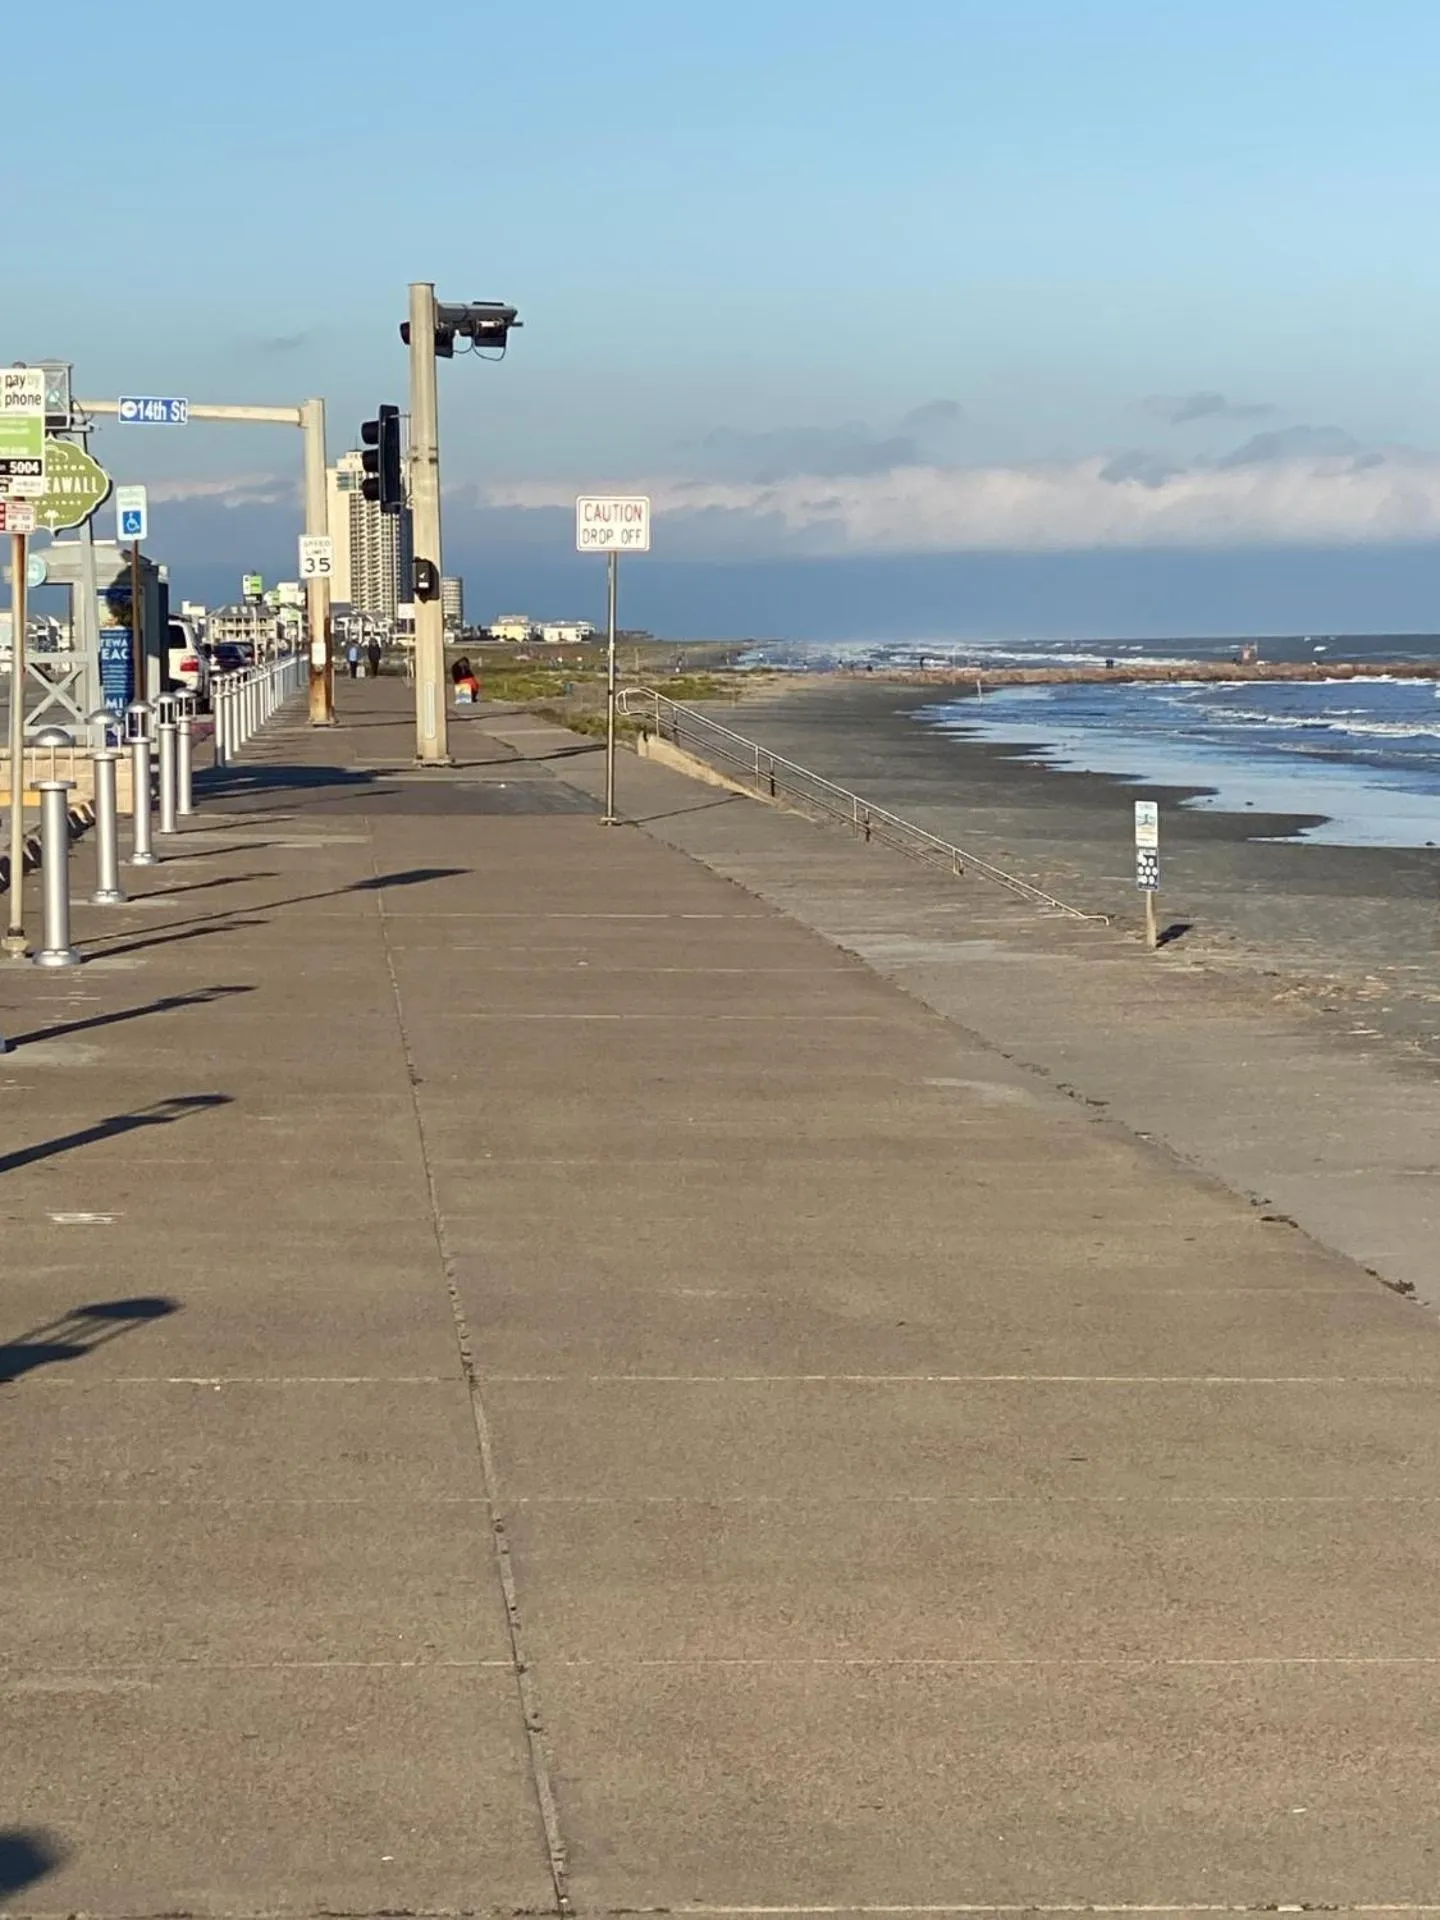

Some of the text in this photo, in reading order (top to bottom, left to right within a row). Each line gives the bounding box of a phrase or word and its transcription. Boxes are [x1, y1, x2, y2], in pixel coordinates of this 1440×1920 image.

[4, 374, 27, 390] pay
[4, 391, 42, 409] phone
[137, 399, 187, 422] 14th St
[9, 460, 40, 475] 5004
[43, 475, 99, 494] EAWALL
[584, 503, 643, 523] CAUTION
[582, 527, 643, 545] DROP OFF
[304, 556, 332, 573] 35
[101, 648, 128, 661] EAC
